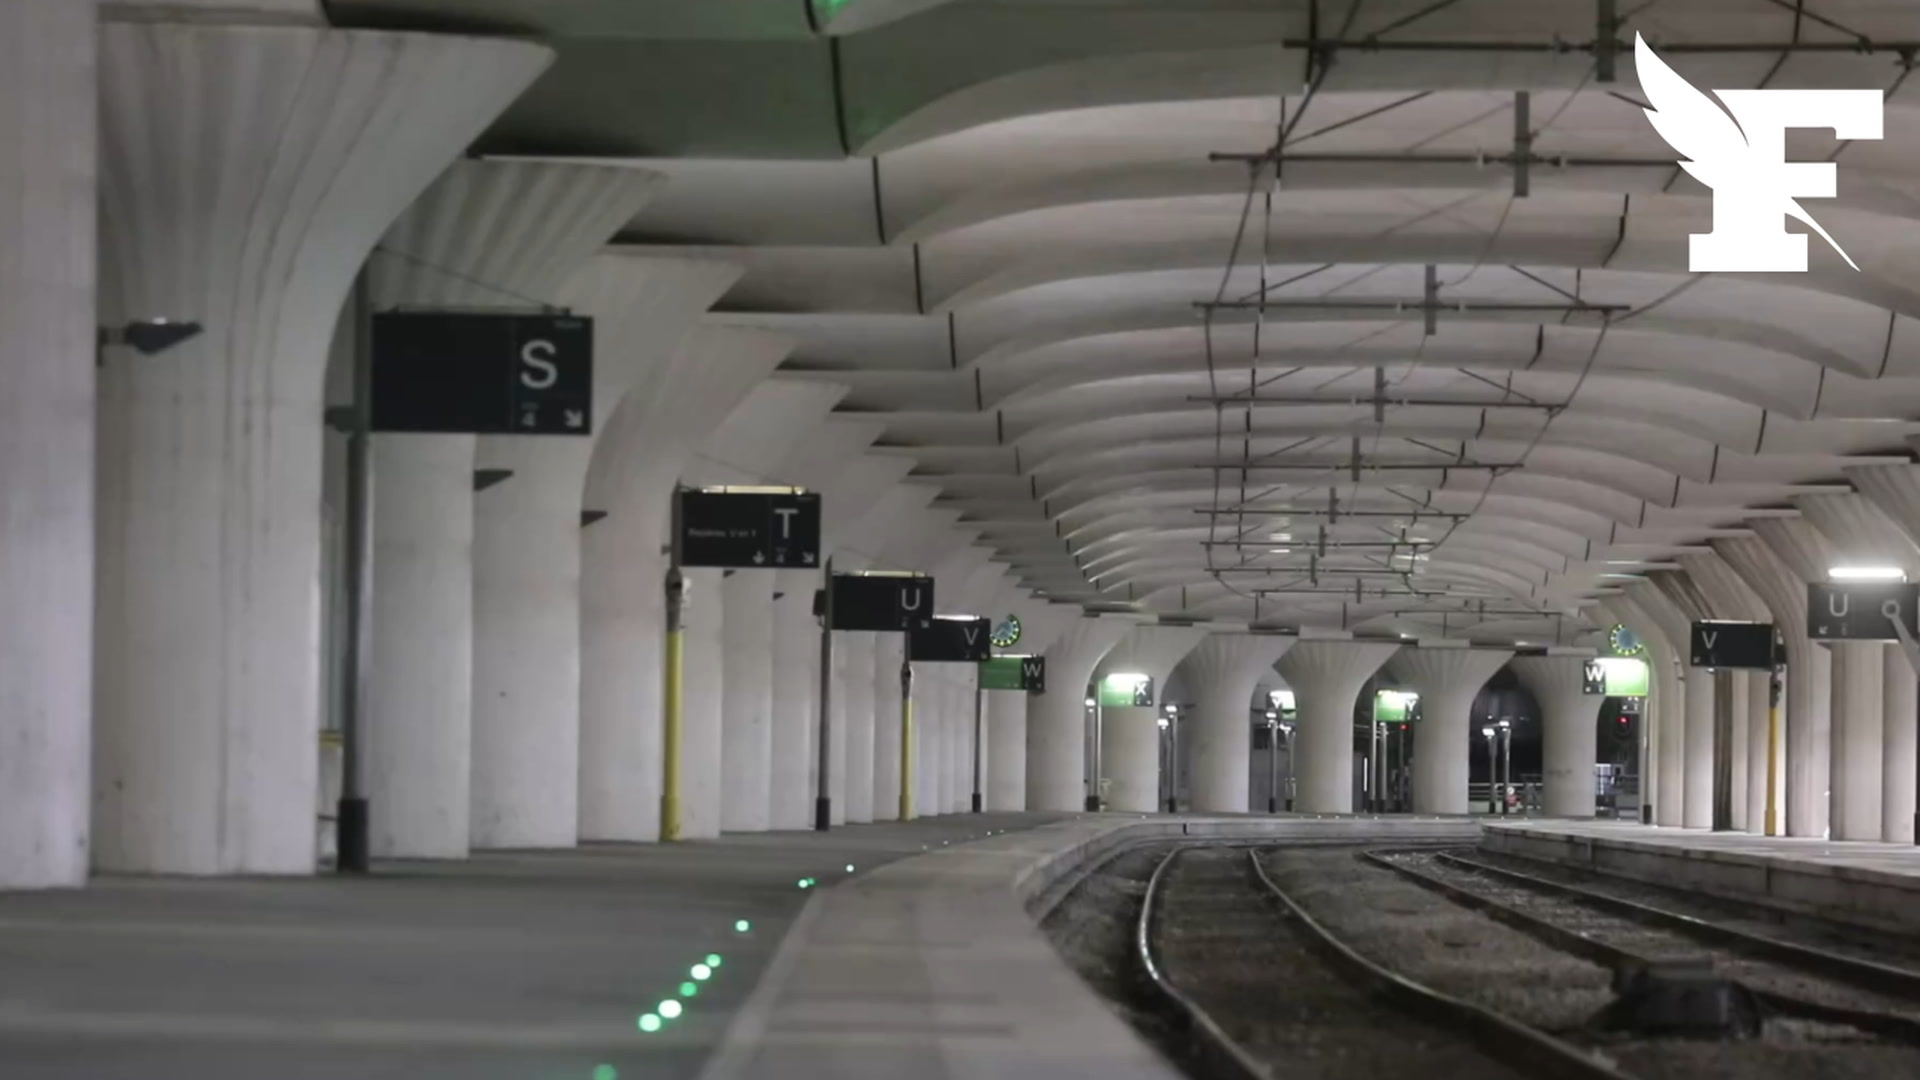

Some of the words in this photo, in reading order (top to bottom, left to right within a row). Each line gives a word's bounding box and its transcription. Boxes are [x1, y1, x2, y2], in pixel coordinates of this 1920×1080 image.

[520, 339, 558, 389] S
[774, 508, 799, 539] T
[901, 588, 921, 610] U
[1829, 593, 1848, 616] U
[963, 627, 979, 646] V
[1702, 631, 1718, 649] V
[1023, 663, 1041, 677] W
[1585, 666, 1605, 682] W
[1135, 682, 1147, 696] X
[1406, 700, 1416, 711] Y
